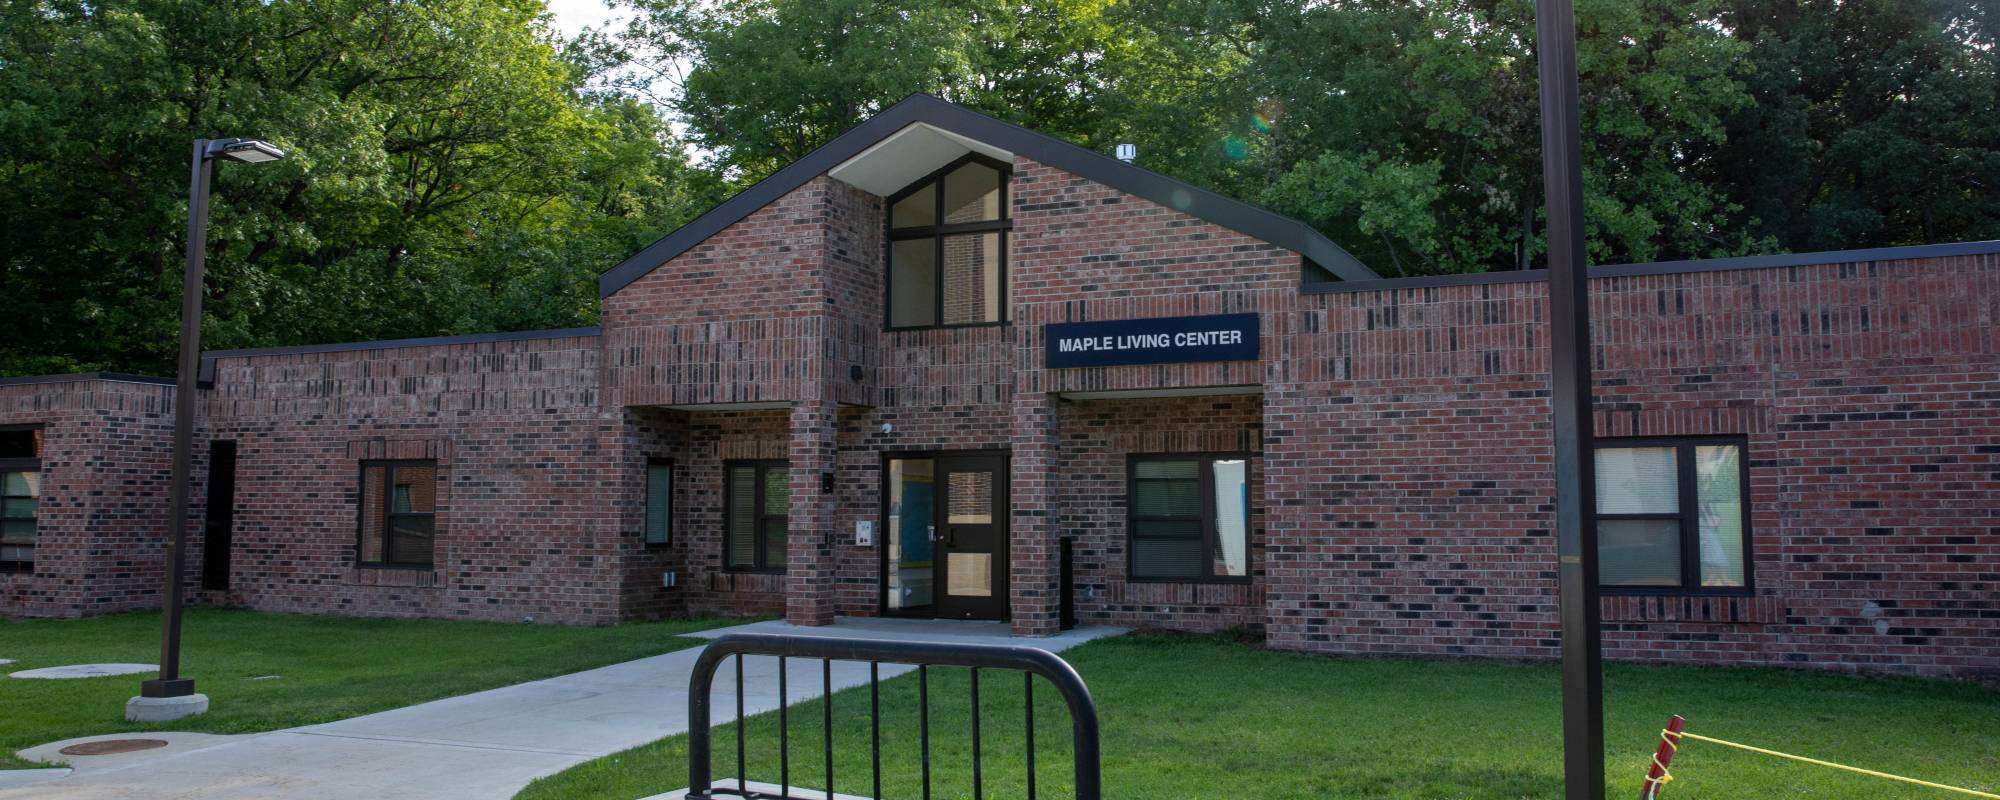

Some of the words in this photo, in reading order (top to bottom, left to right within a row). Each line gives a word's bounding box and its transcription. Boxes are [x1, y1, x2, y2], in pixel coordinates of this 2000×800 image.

[1059, 336, 1113, 353] MAPLE
[1117, 333, 1170, 350] LIVING
[1174, 330, 1242, 347] CENTER
